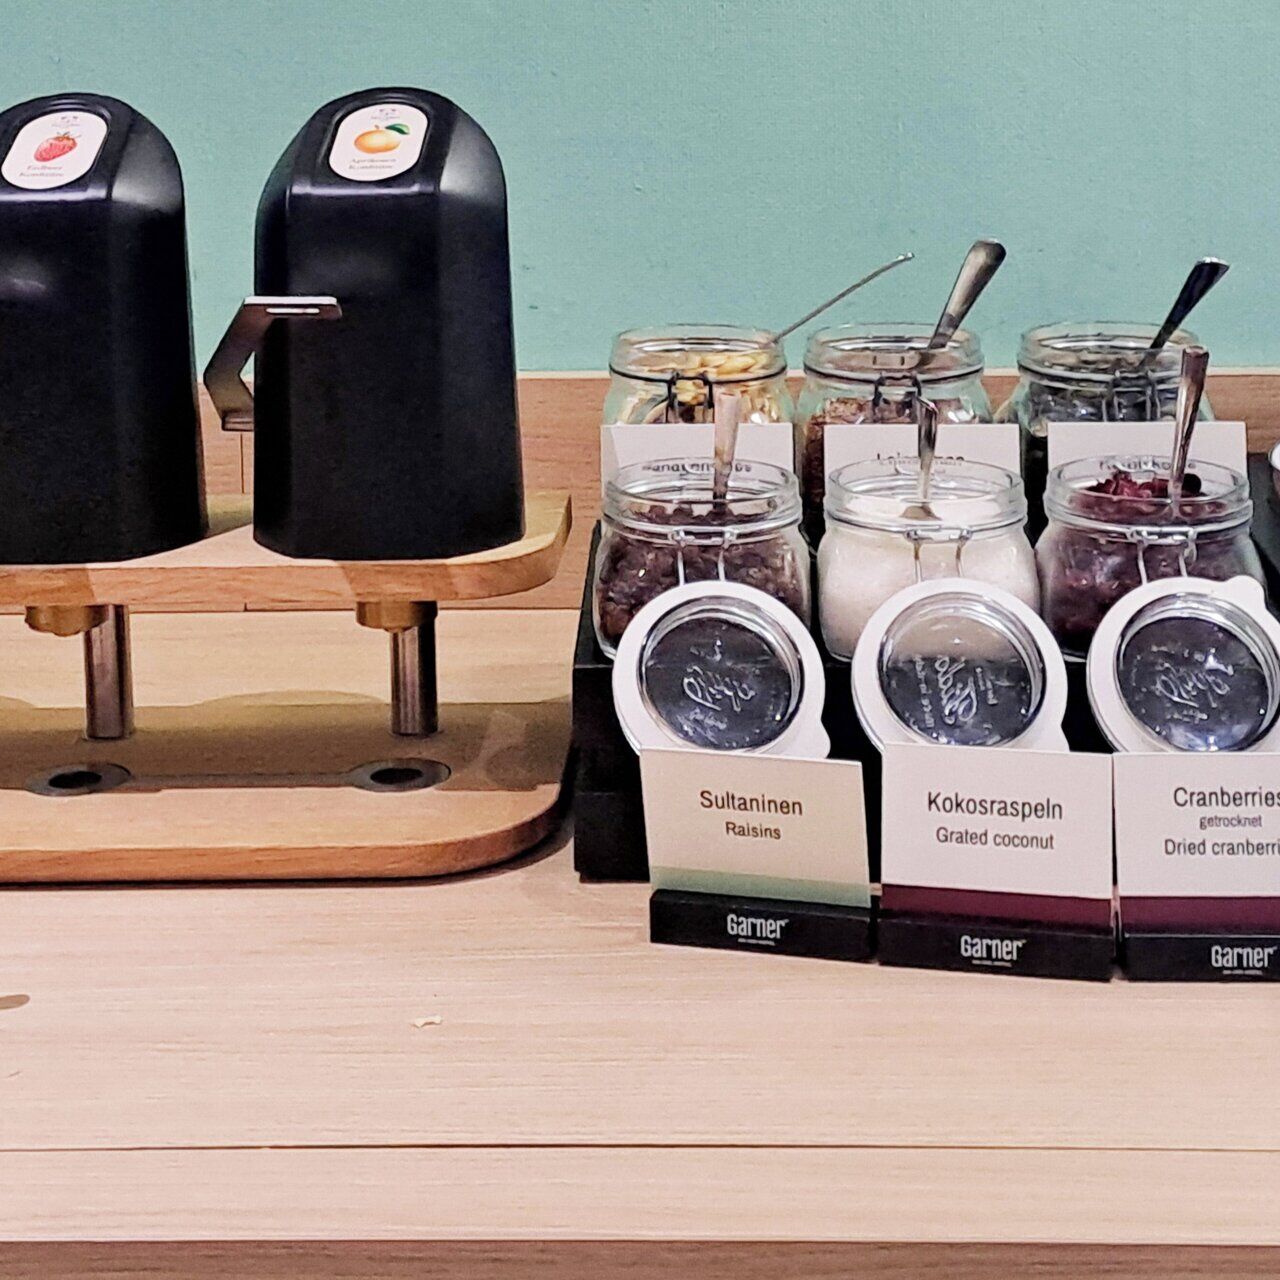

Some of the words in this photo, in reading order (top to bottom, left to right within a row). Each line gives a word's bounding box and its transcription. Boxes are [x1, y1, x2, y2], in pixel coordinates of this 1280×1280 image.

[699, 789, 803, 816] Sultaninen
[927, 791, 1063, 822] Kokosraspeln
[724, 821, 782, 840] Raisins
[1199, 814, 1263, 830] getrocknet
[935, 826, 988, 846] Grated
[992, 833, 1055, 850] coconut
[1164, 838, 1207, 856] Dried
[726, 913, 787, 939] Garner
[960, 935, 1023, 961] Garner
[1211, 945, 1274, 968] Garner
